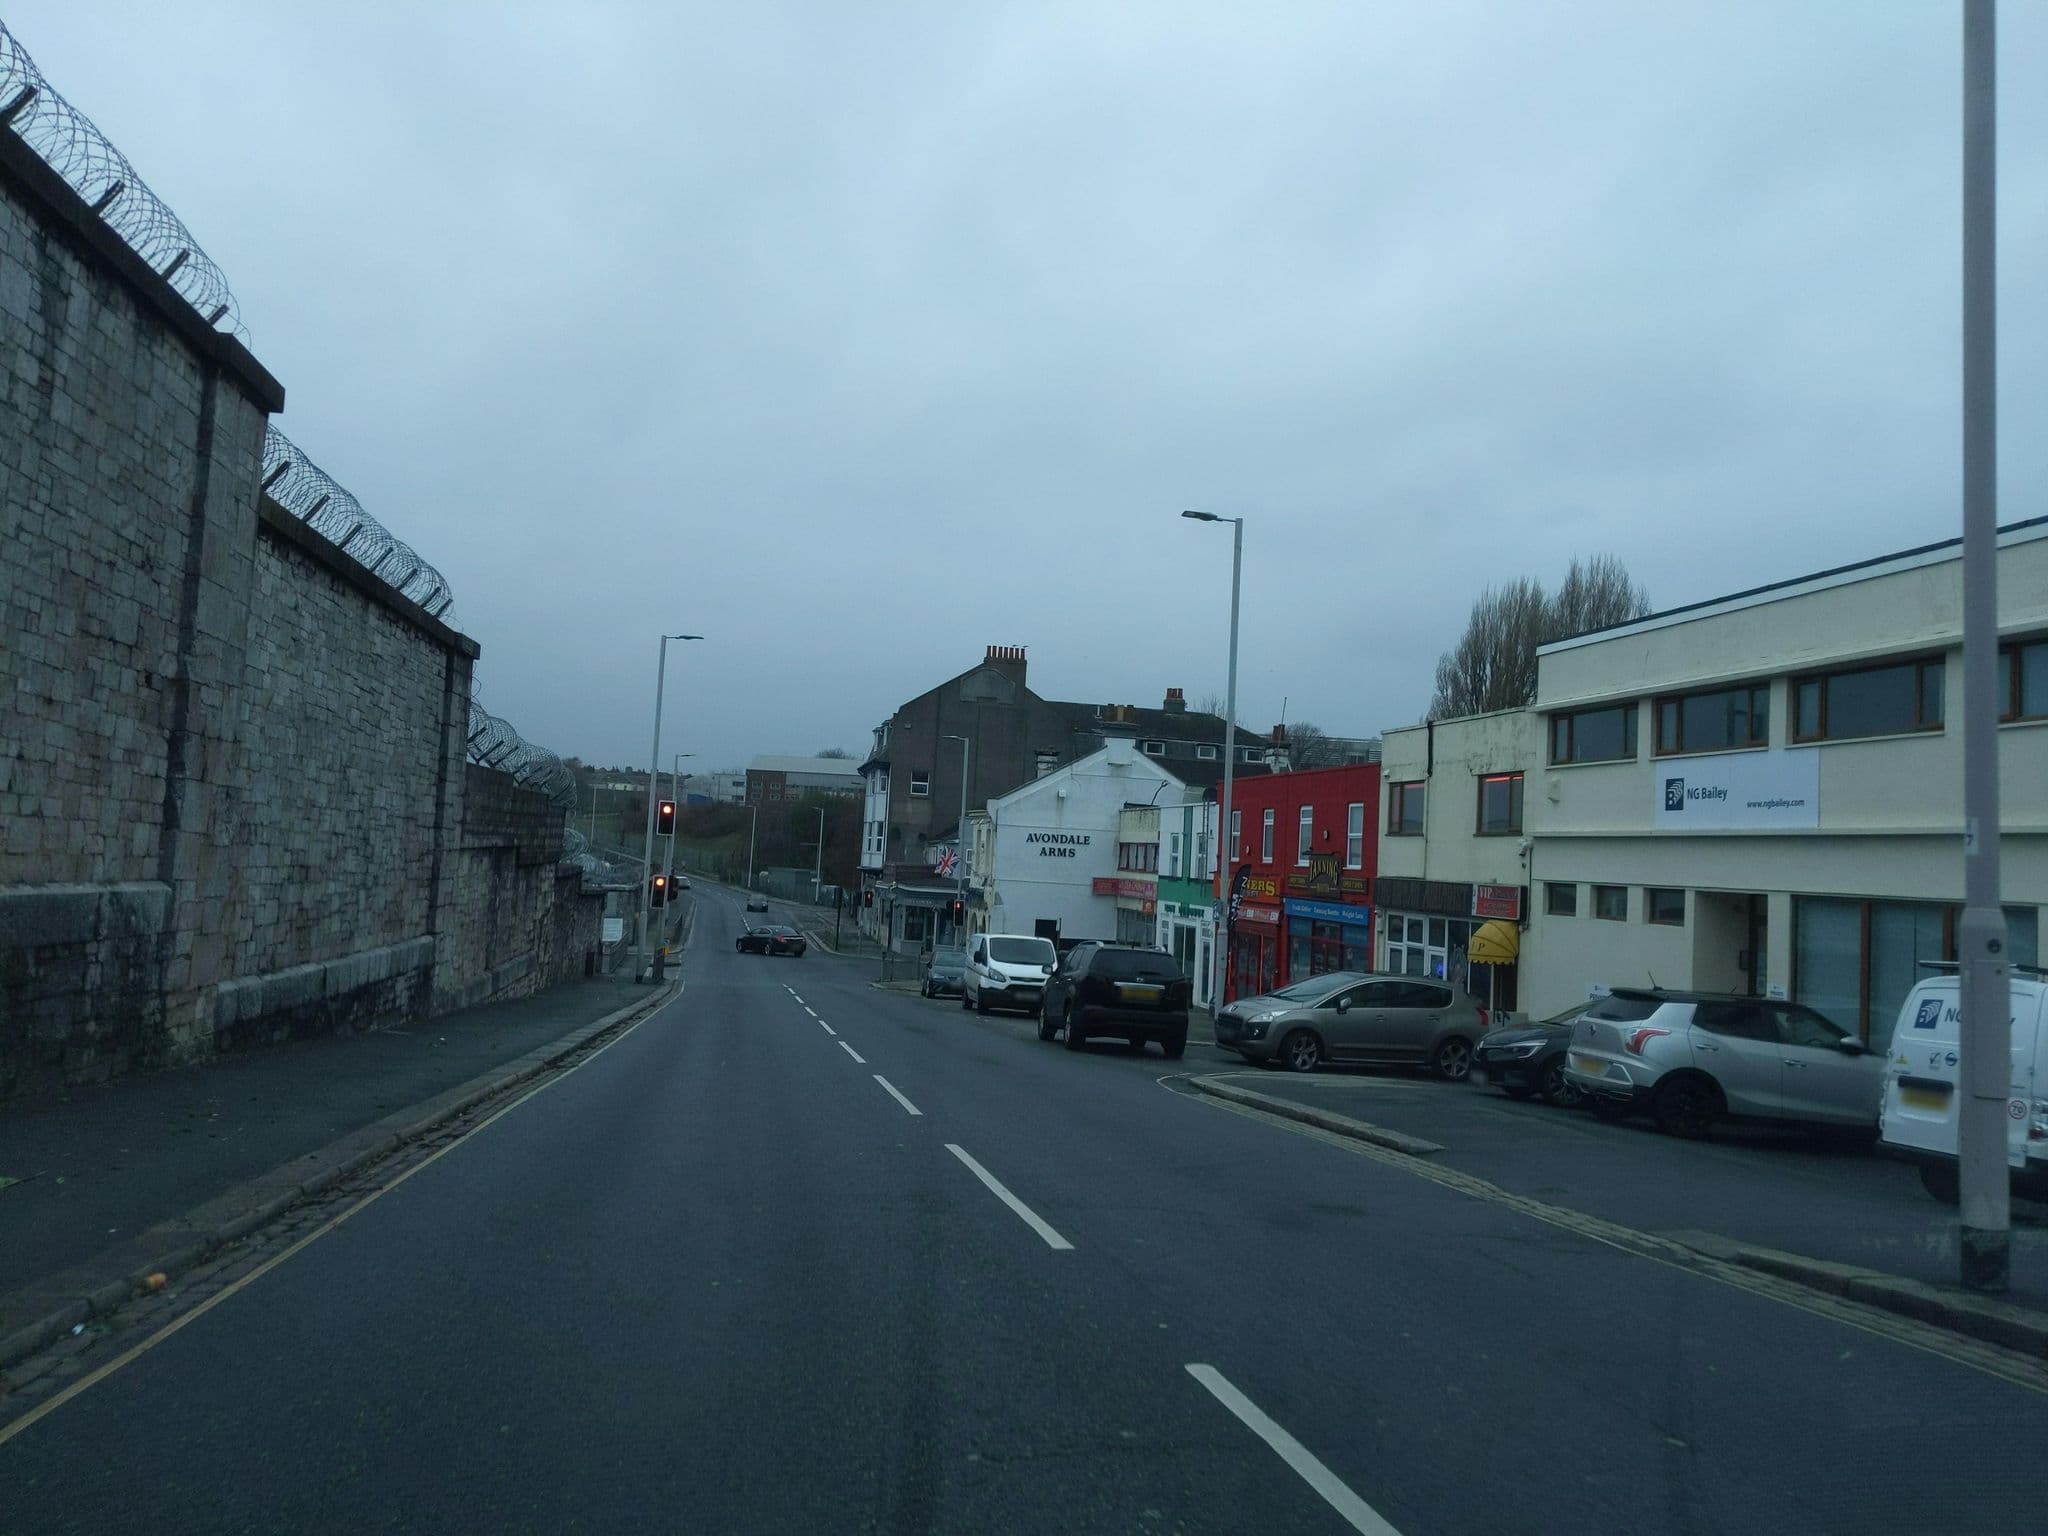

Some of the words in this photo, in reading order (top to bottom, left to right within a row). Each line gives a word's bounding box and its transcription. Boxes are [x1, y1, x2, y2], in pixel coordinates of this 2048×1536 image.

[1687, 788, 1700, 800] NG
[1701, 786, 1728, 801] Bailey
[1747, 799, 1805, 809] www.ngbailey.com
[1026, 833, 1090, 845] AVONDALE
[1040, 847, 1075, 857] ARMS
[1310, 859, 1338, 886] TANNING
